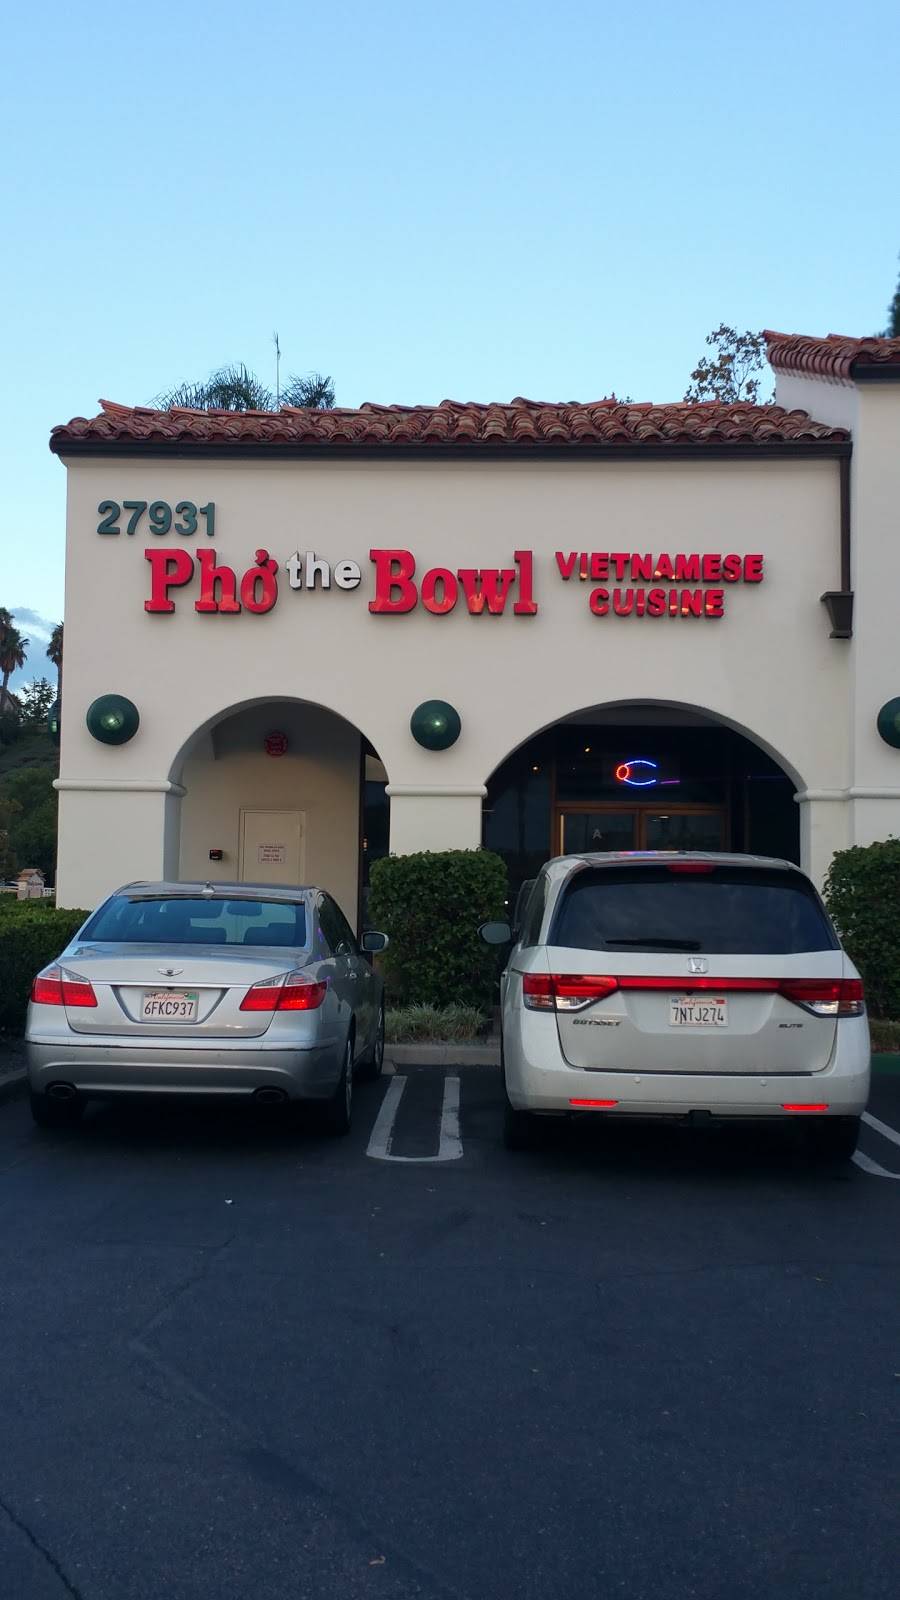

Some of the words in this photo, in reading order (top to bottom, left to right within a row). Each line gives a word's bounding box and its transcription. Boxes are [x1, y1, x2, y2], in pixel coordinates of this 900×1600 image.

[97, 500, 216, 537] 27931
[286, 551, 362, 590] the
[368, 549, 538, 615] Bowl
[555, 552, 764, 583] VIETNAMESE
[589, 588, 724, 617] CUISINE
[144, 1001, 194, 1016] 6FKC937
[672, 1007, 724, 1022] 7NTJ274
